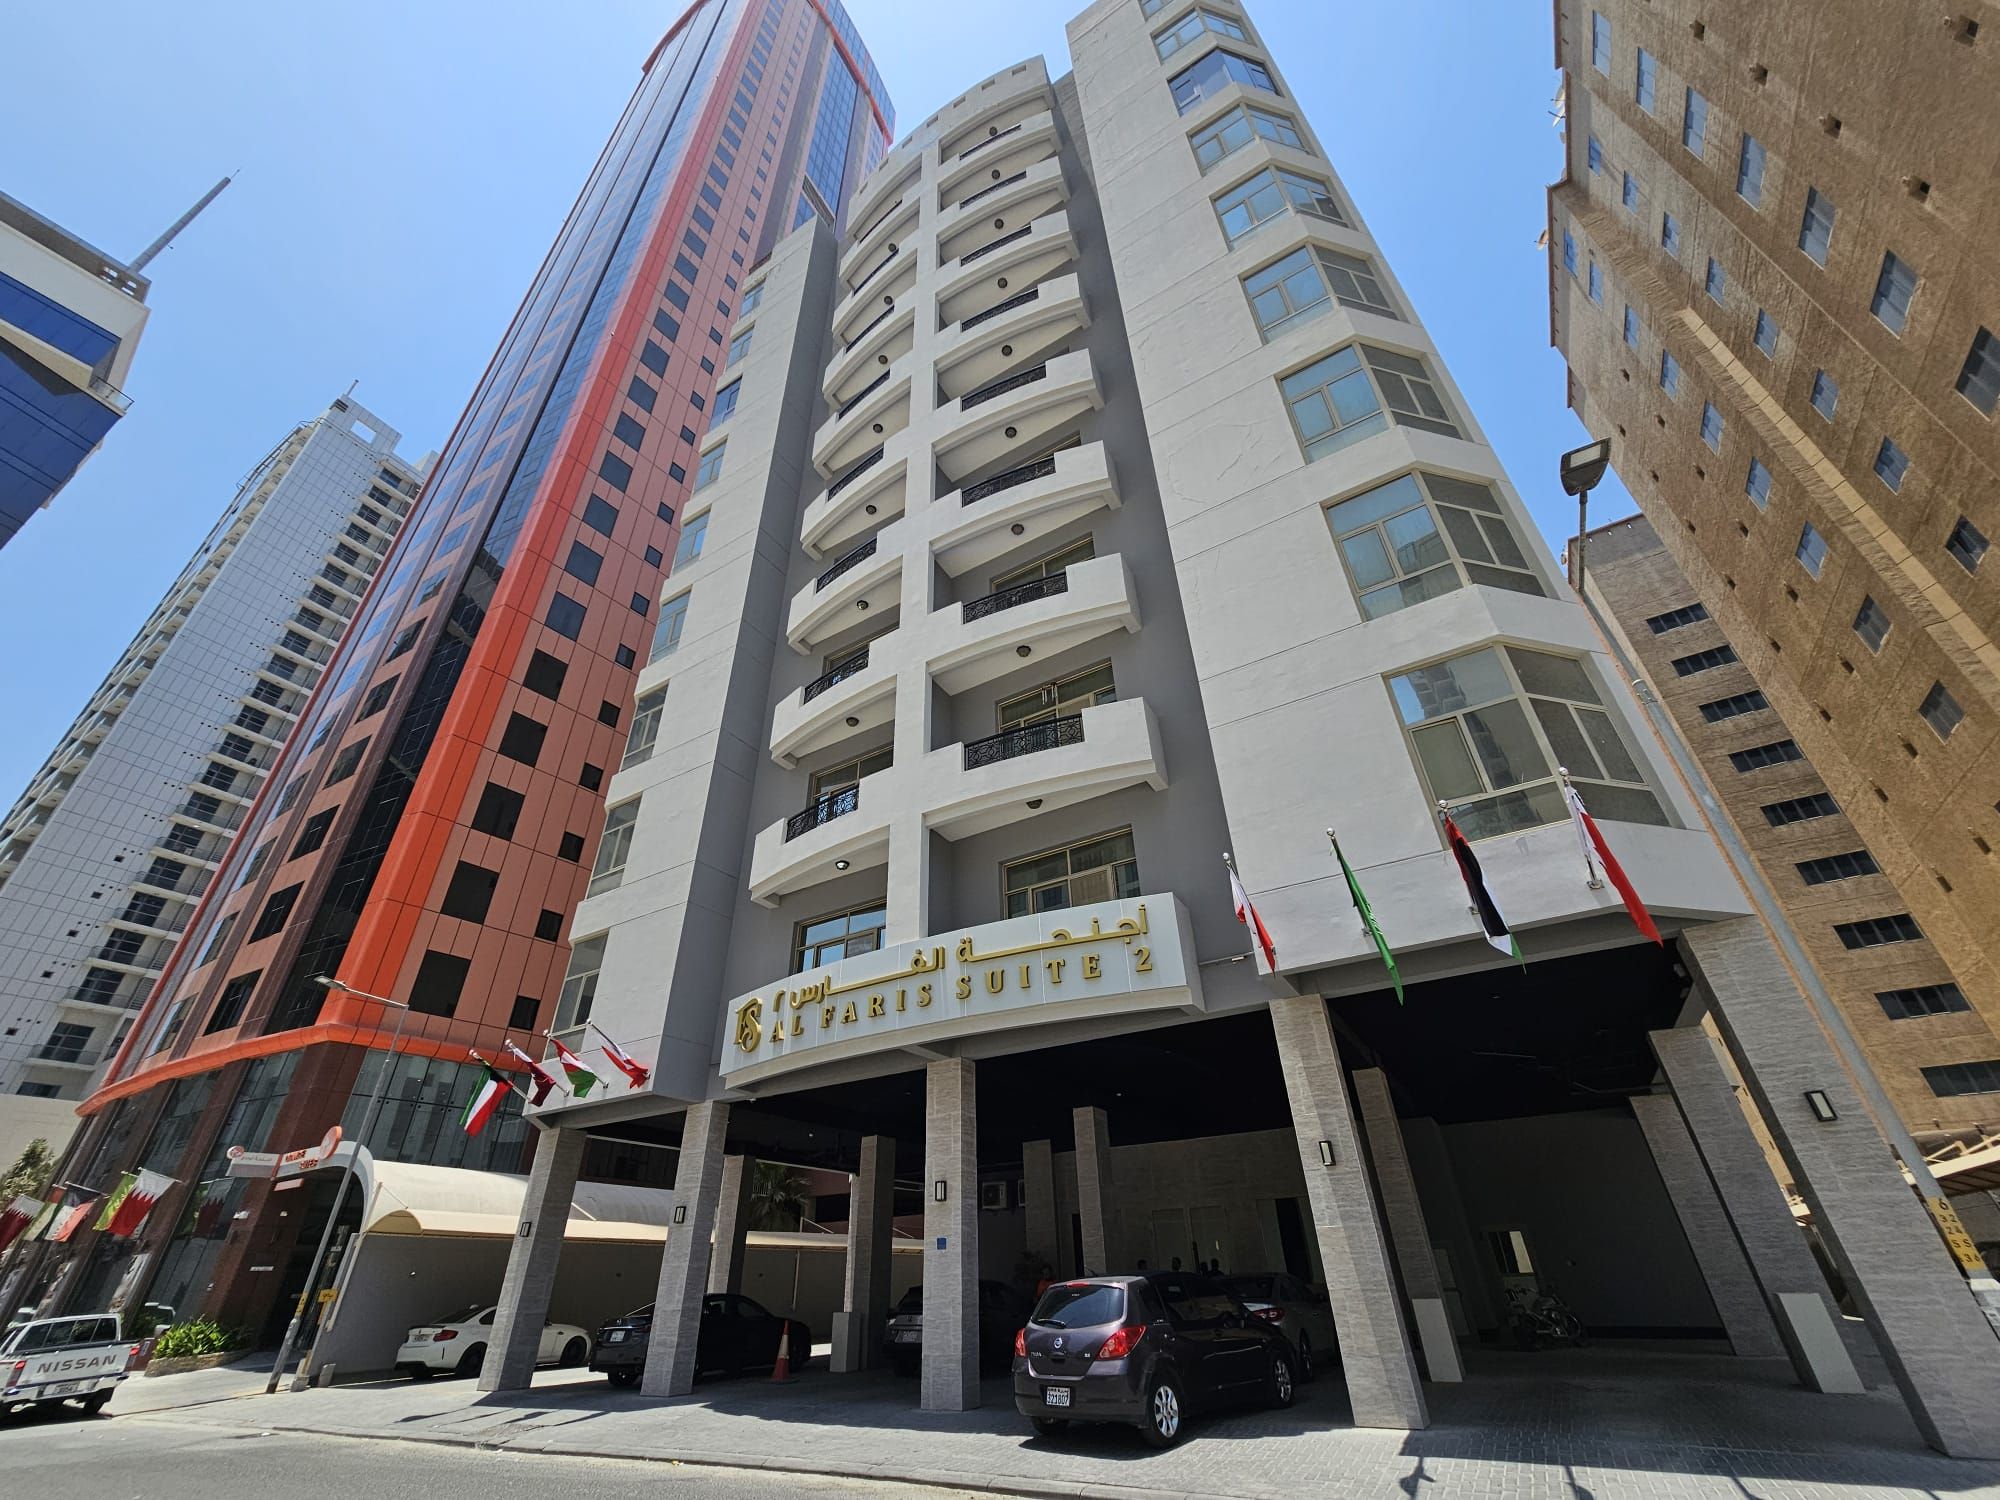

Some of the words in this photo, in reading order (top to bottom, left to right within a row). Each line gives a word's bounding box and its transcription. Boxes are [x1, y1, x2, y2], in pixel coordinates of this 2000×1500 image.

[956, 903, 1149, 963] أجنحة
[769, 1013, 805, 1043] AL
[820, 982, 933, 1029] FARIS
[956, 953, 1102, 1000] SUITE
[1134, 945, 1153, 973] 2
[789, 945, 946, 1011] الفارس
[36, 1354, 117, 1374] NISSAN
